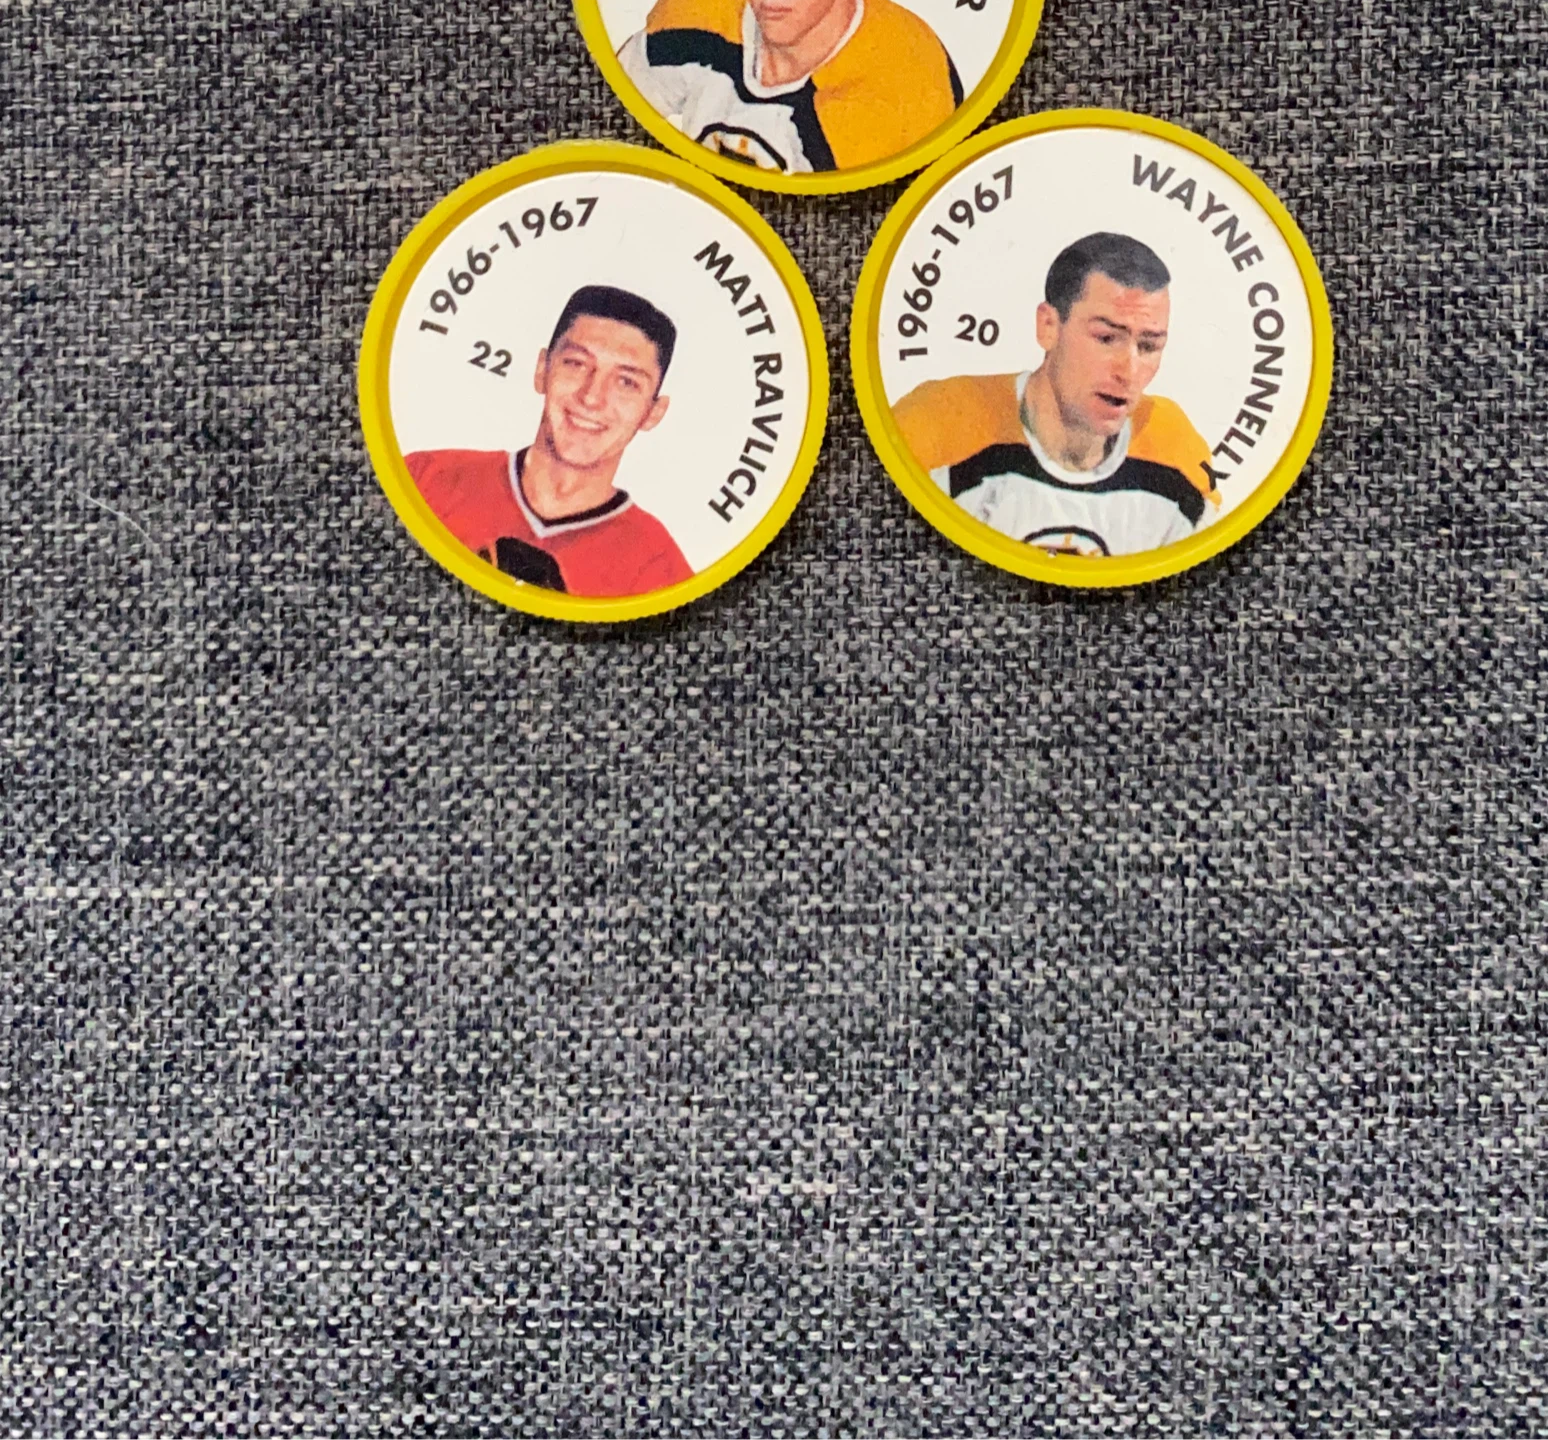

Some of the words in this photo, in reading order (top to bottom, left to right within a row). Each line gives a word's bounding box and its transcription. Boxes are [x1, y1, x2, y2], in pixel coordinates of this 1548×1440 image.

[419, 197, 599, 336] 1966-1967
[693, 240, 776, 339] MATT
[899, 164, 1014, 361] 1966-1967
[955, 314, 1000, 346] 20
[1132, 154, 1264, 272] WAYNE
[1199, 282, 1285, 490] CONNELLY
[468, 340, 513, 377] 22
[708, 352, 784, 523] RAVLICH
